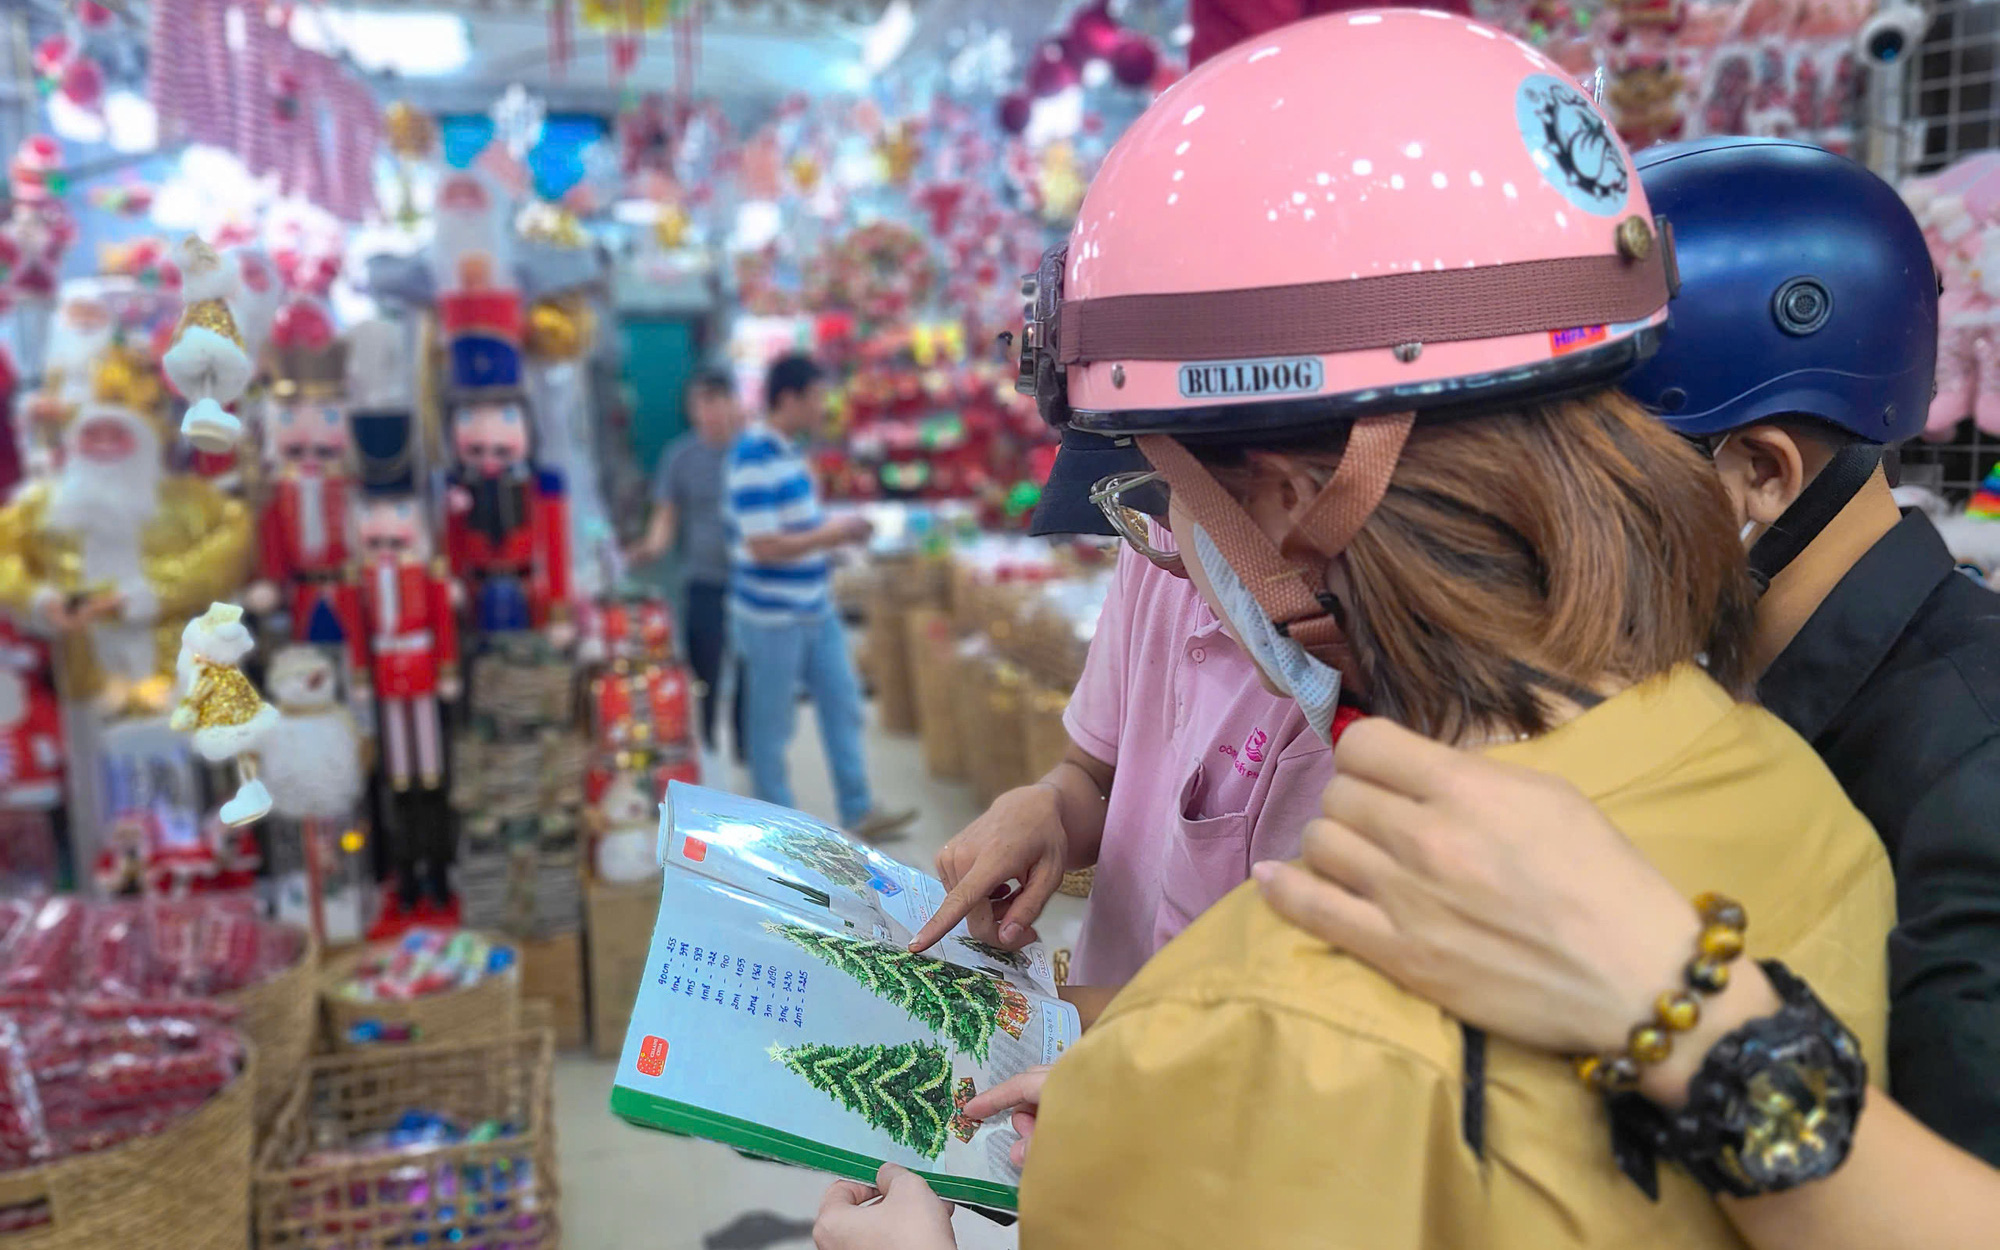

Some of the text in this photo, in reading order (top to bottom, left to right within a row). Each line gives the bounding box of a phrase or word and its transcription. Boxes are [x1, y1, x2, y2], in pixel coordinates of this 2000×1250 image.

[1187, 362, 1312, 393] BULLDOG
[658, 963, 670, 984] 90cm
[667, 937, 676, 953] 255
[685, 979, 695, 996] 1m5
[694, 947, 703, 961] 589
[736, 958, 745, 976] 1055
[671, 976, 681, 993] 1m2
[701, 983, 710, 1001] 1m8
[708, 952, 717, 966] 722
[715, 990, 725, 1004] 2m
[720, 955, 730, 968] 900
[747, 995, 759, 1015] 2m4
[764, 1005, 772, 1017] 3m
[779, 1005, 789, 1022] 3m6
[794, 1006, 803, 1028] 4m5
